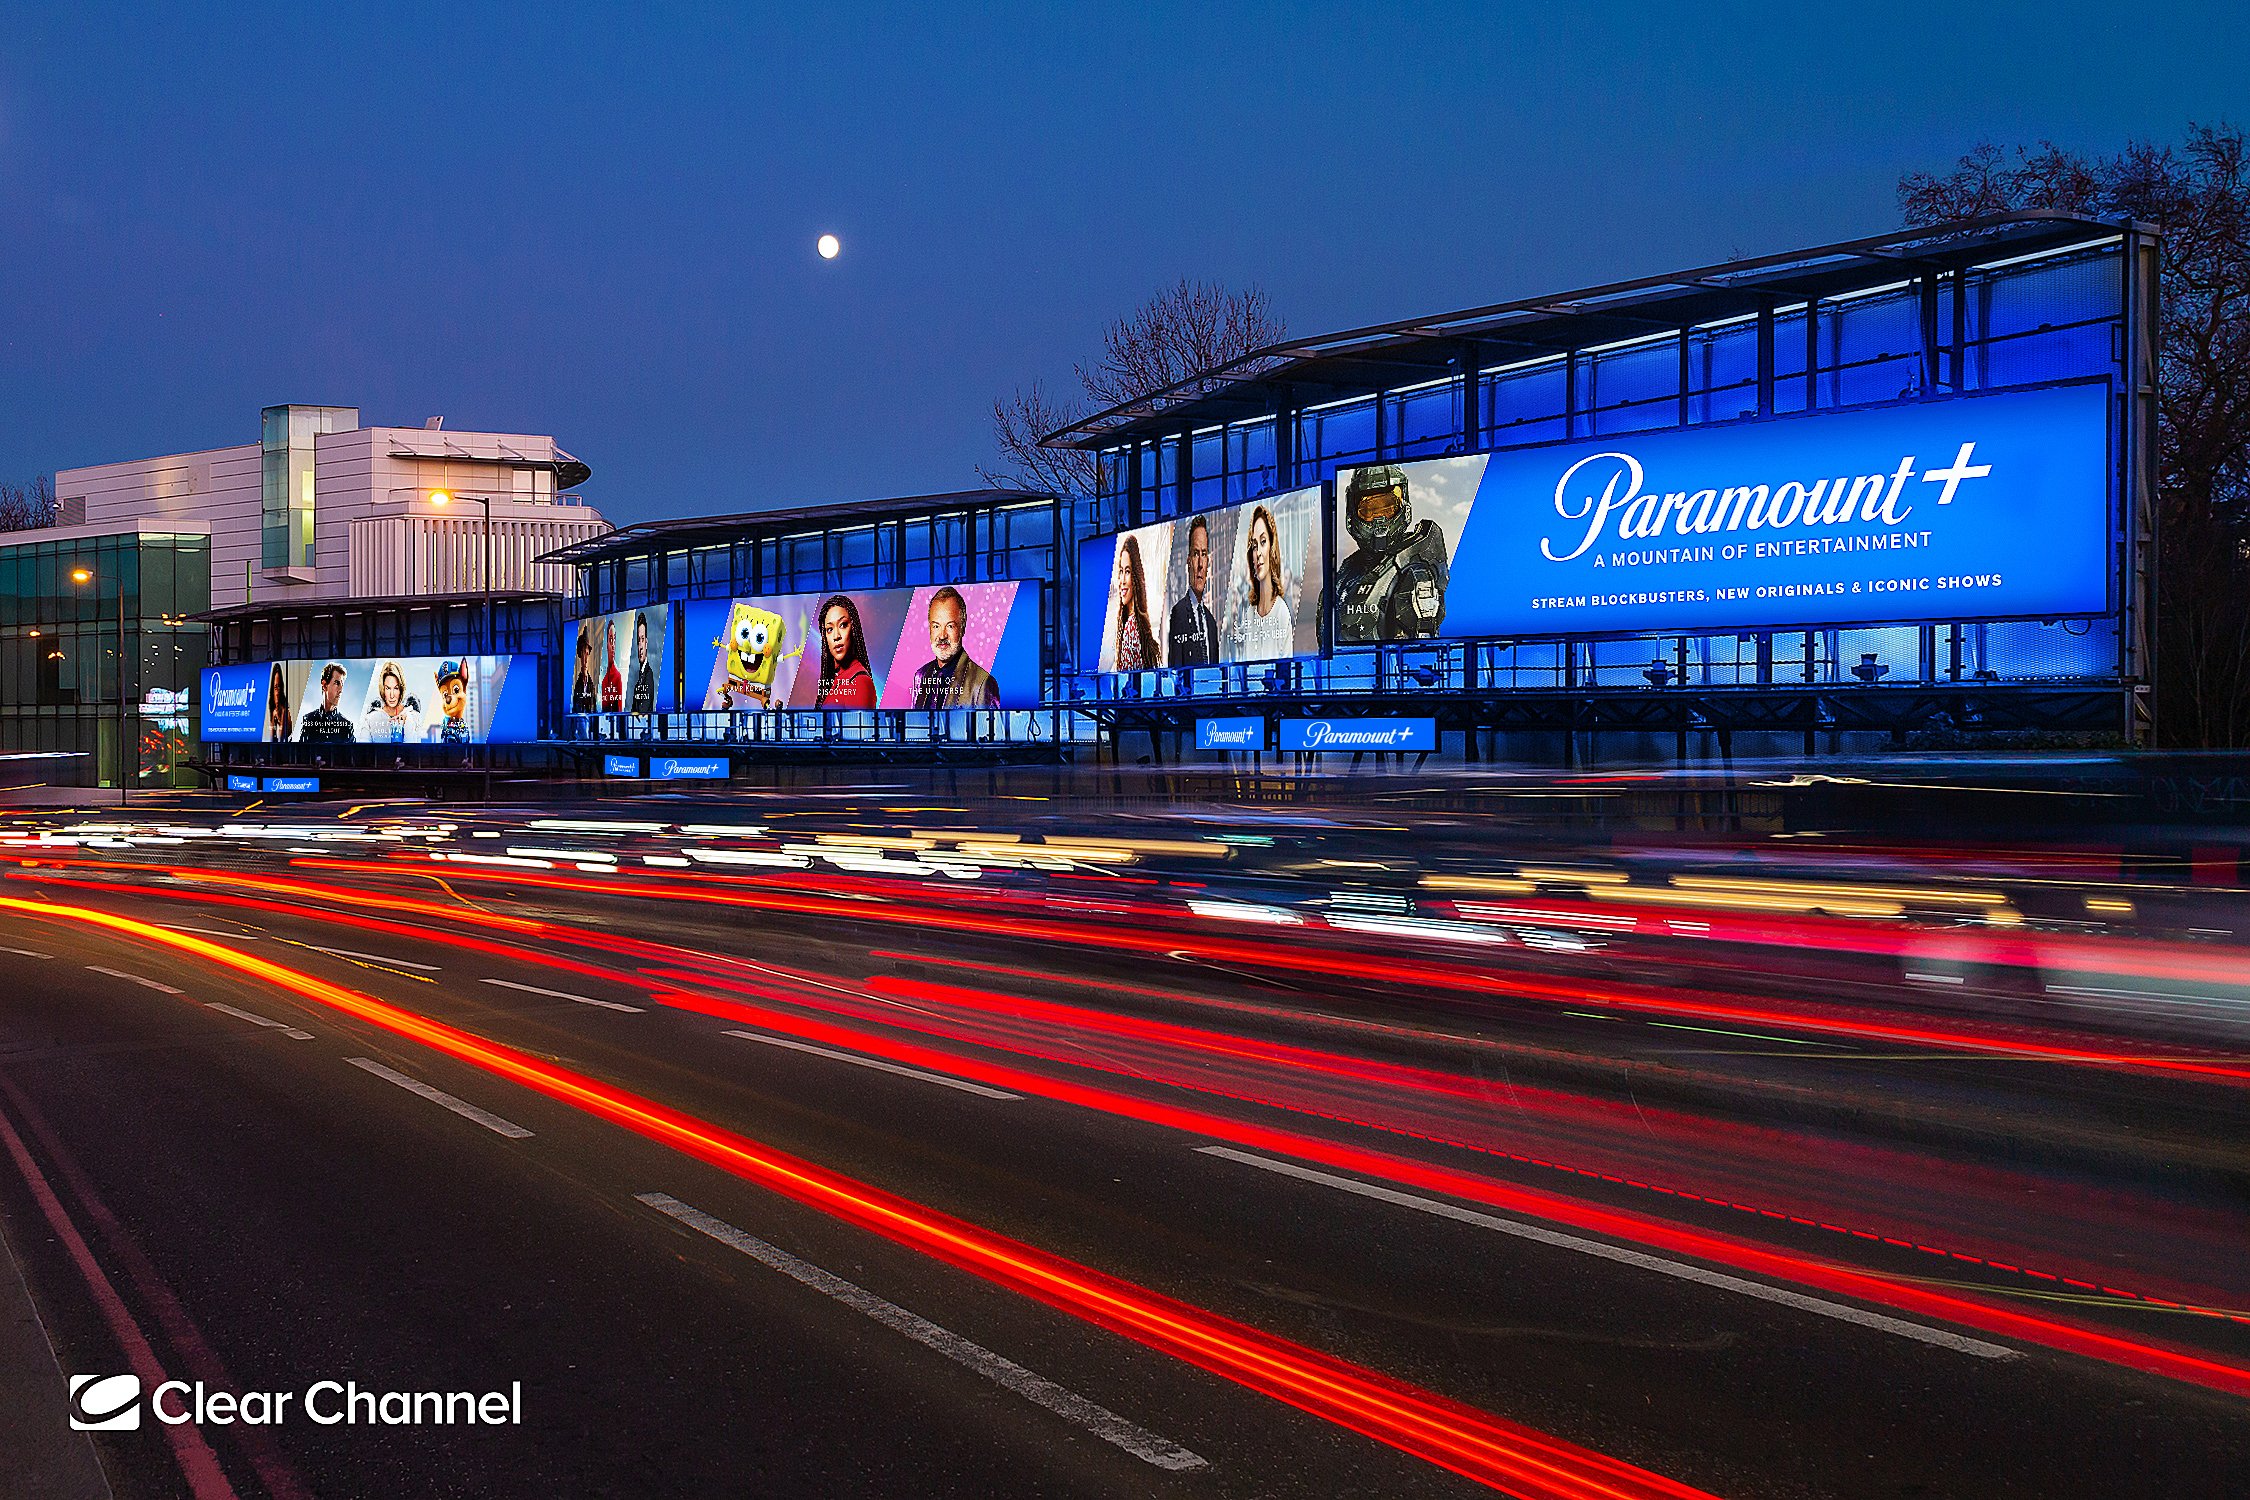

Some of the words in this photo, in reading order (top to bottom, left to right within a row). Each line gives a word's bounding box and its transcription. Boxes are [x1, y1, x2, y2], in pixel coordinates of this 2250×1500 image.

[1540, 442, 1993, 562] Paramount+
[1593, 554, 1606, 568] A
[1612, 546, 1714, 567] MOUNTAIN
[1721, 543, 1748, 560] OF
[1755, 531, 1932, 558] ENTERTAINMENT
[1531, 596, 1586, 609] STREAM
[1591, 589, 1710, 606] BLOCKBUSTERS,
[1716, 587, 1750, 600] NEW
[1756, 582, 1845, 598] ORIGINALS
[1851, 581, 1862, 594] &
[1868, 577, 1930, 593] ICONIC
[1937, 573, 2002, 589] SHOWS
[1347, 603, 1378, 614] HALO
[817, 688, 857, 696] DISCOVERY
[1204, 720, 1254, 747] Paramount+
[1303, 721, 1414, 748] Paramount+
[662, 759, 719, 776] Paramount+
